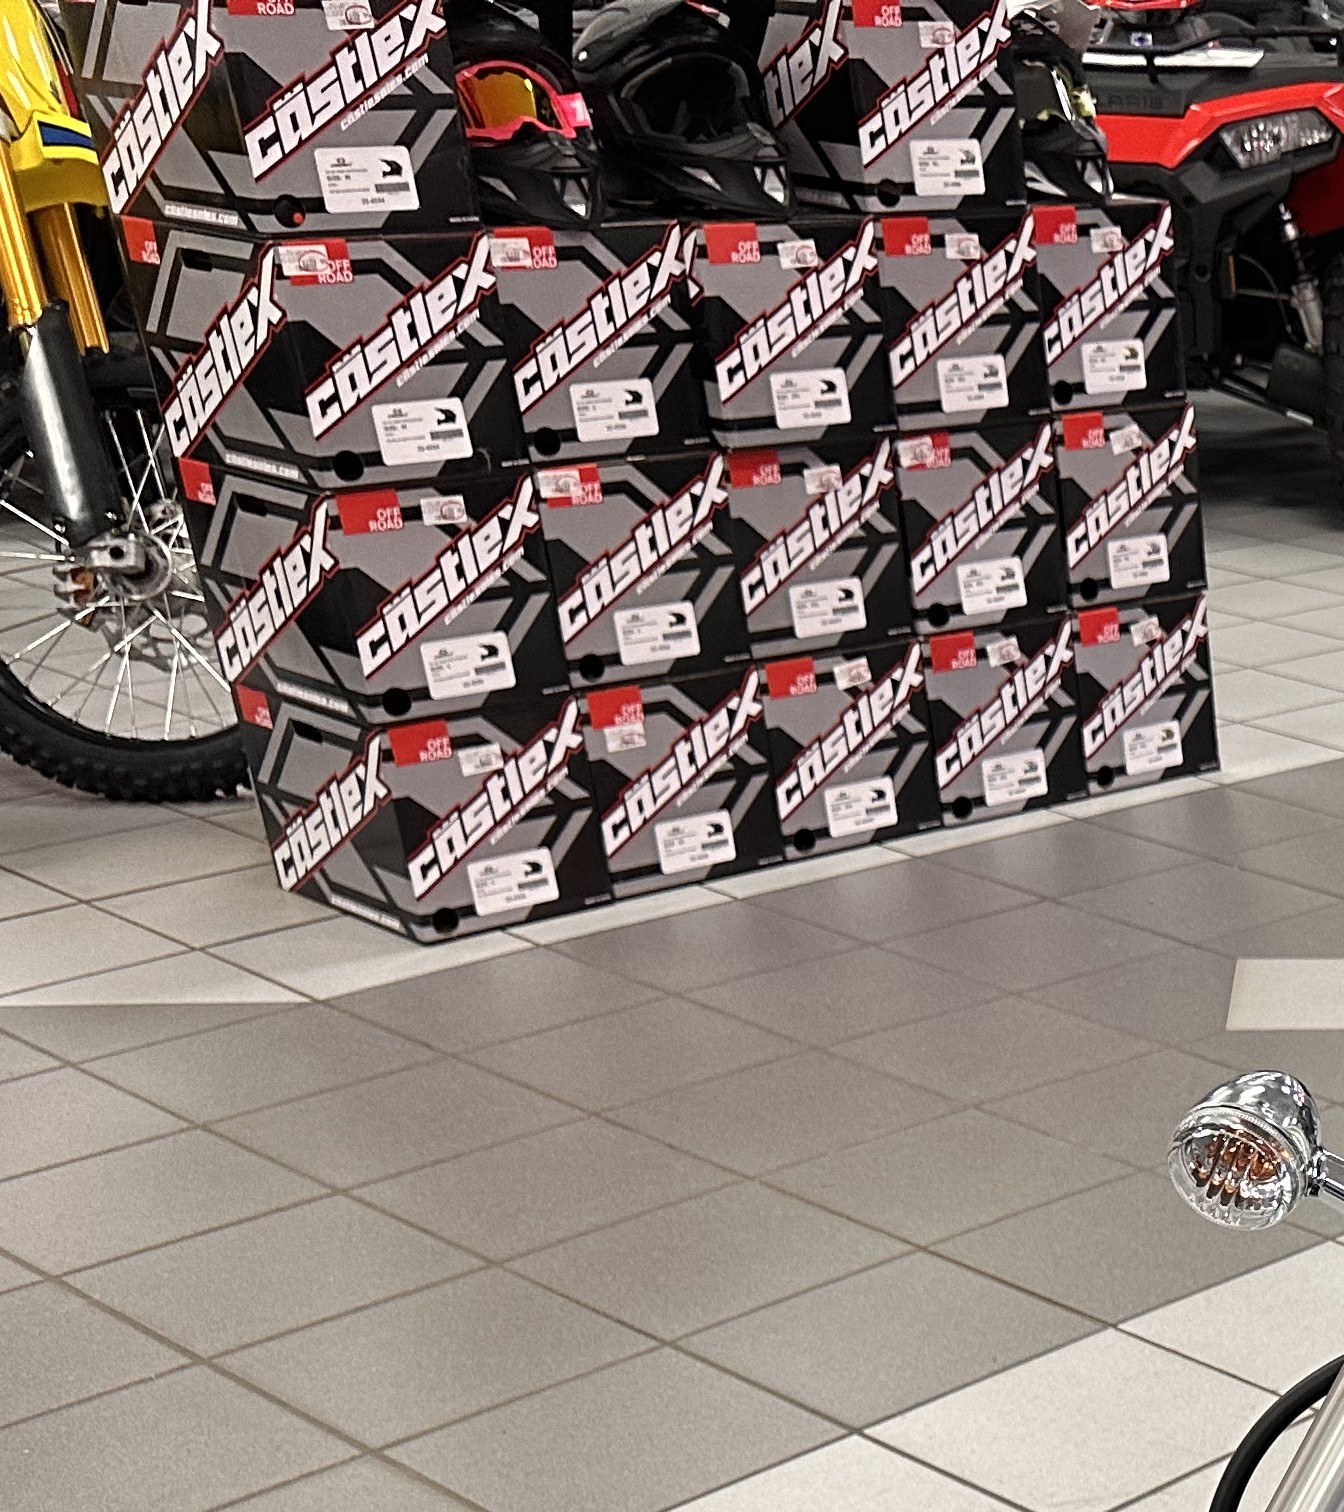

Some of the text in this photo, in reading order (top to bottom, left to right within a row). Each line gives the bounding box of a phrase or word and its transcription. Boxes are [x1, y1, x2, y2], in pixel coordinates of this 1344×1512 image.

[257, 3, 295, 16] ROAD
[881, 6, 901, 18] OFF
[874, 16, 902, 27] ROAD
[318, 271, 353, 284] ROAD
